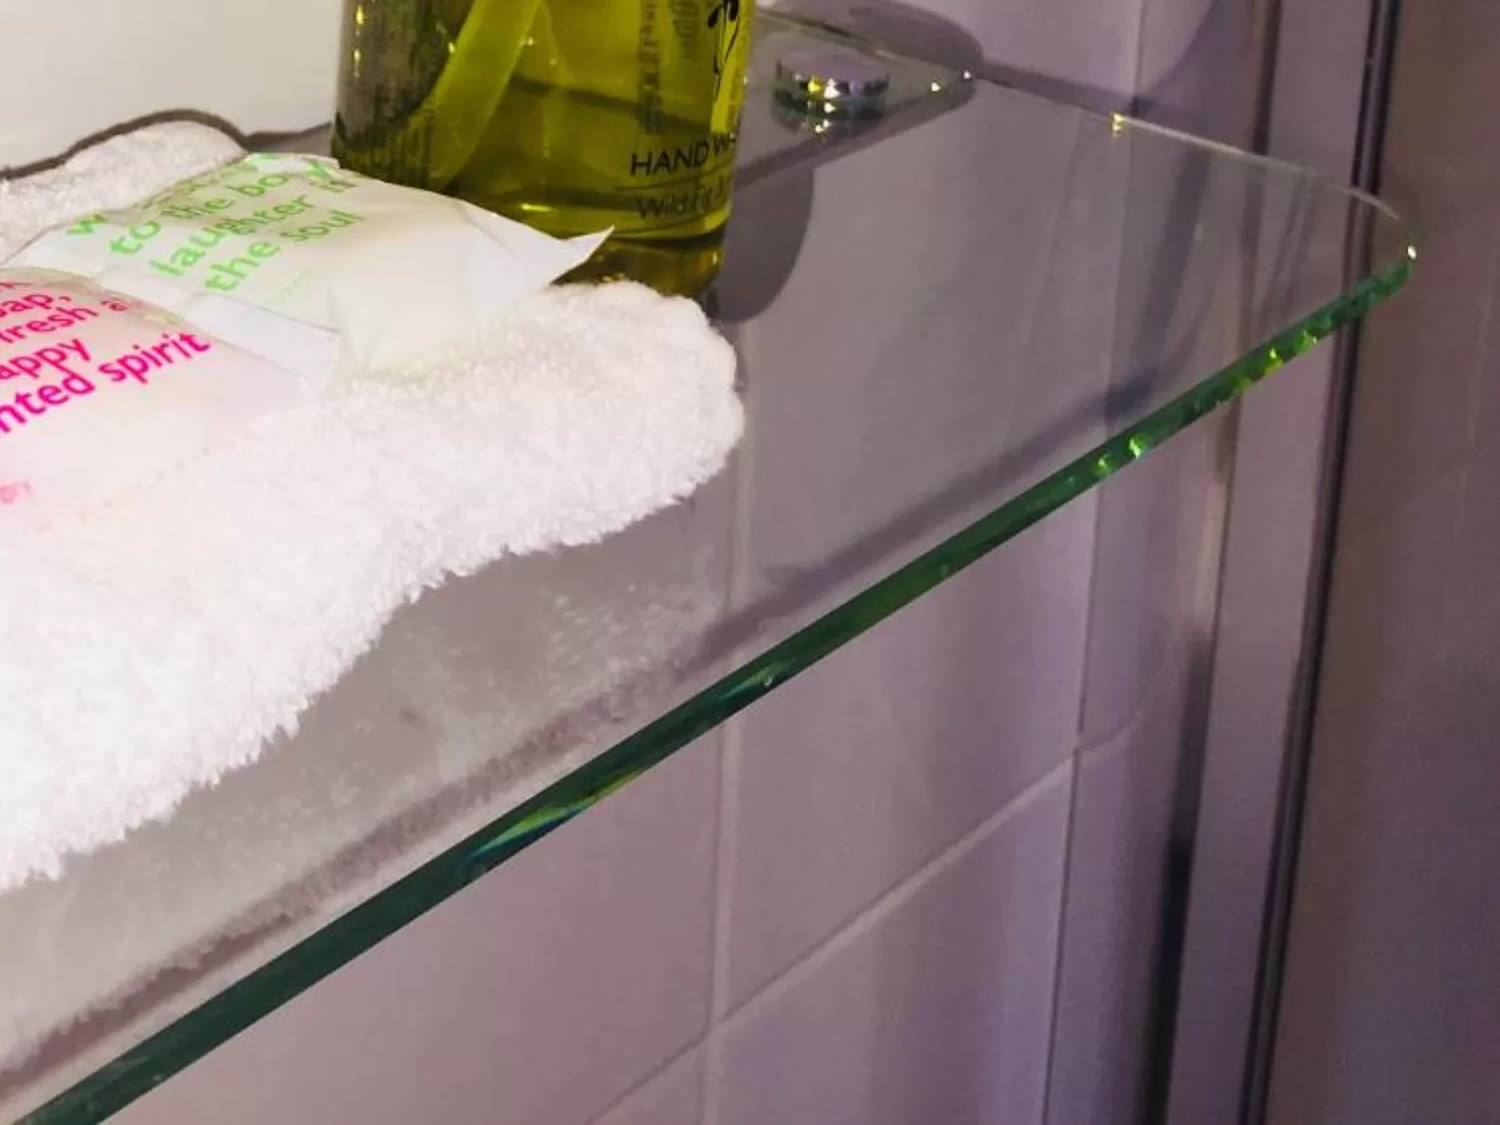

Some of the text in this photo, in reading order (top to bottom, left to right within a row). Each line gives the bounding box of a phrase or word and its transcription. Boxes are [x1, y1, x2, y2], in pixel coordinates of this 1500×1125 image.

[203, 208, 367, 292] the soul
[97, 331, 212, 385] spirit
